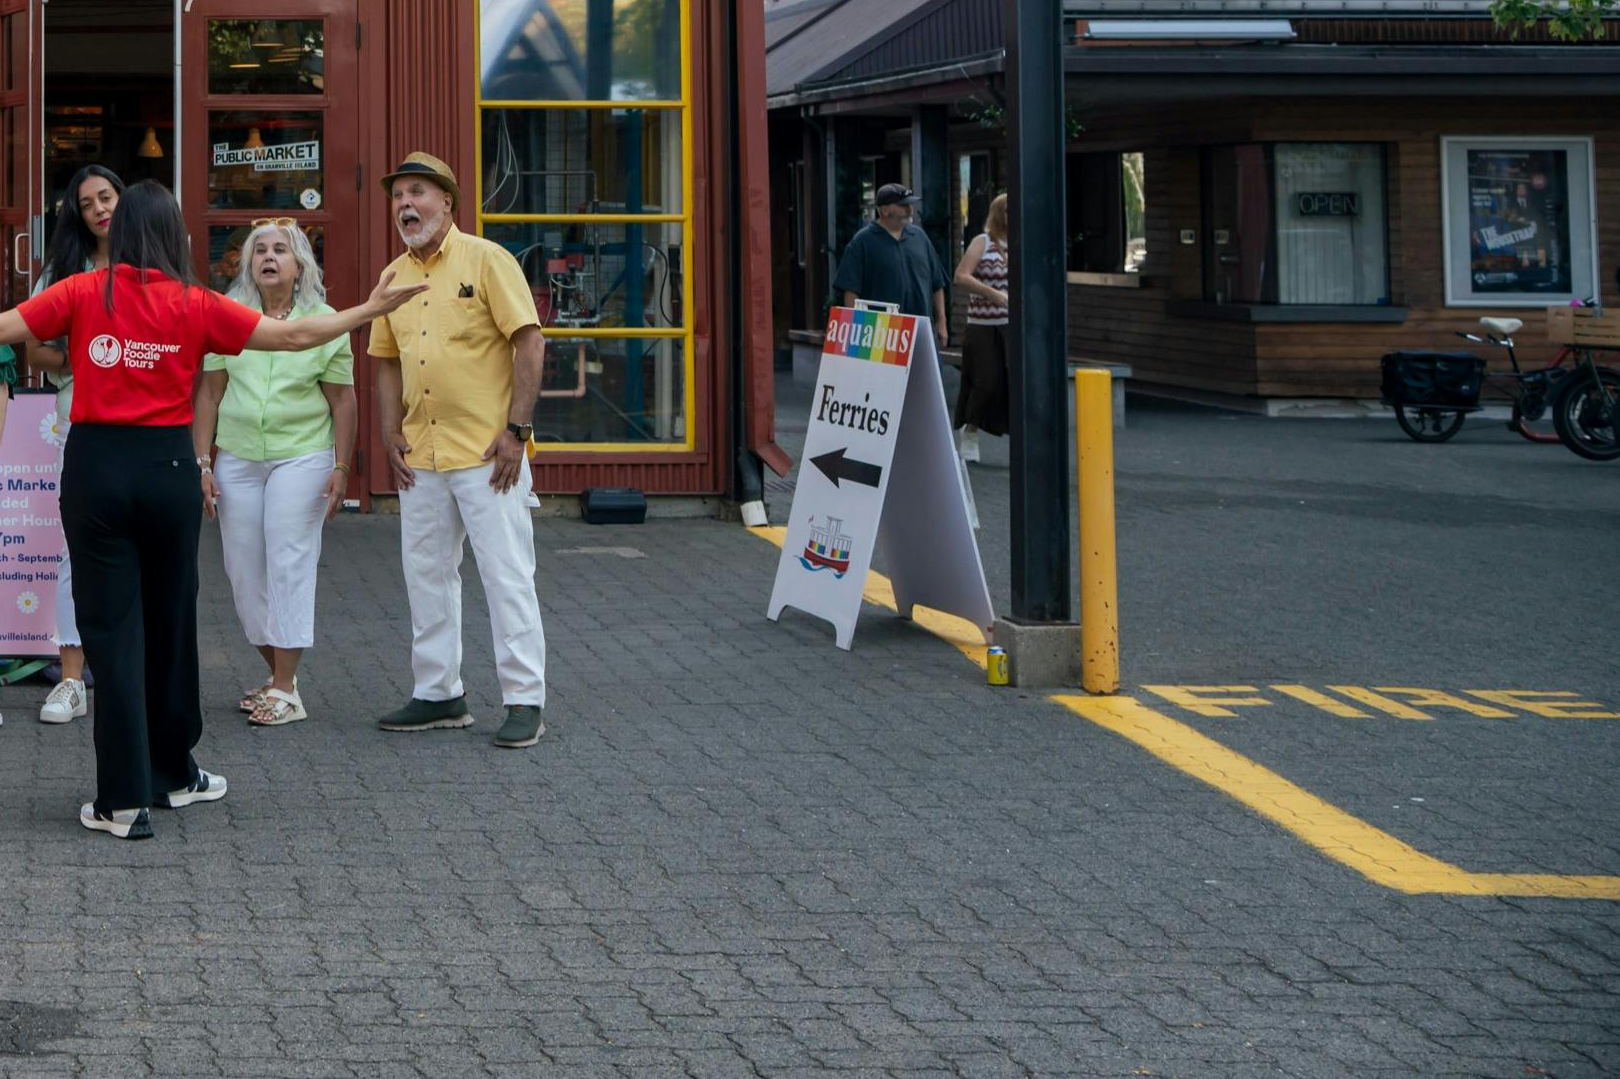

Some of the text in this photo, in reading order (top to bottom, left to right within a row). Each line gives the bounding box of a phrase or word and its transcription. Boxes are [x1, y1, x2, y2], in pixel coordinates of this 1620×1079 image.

[215, 143, 316, 164] PUBLIC MARKET
[1300, 193, 1358, 215] OPEN
[124, 339, 181, 353] Vancouver
[826, 318, 911, 355] aquabus
[123, 348, 161, 361] Foodie
[124, 357, 154, 369] Tours
[816, 384, 891, 436] Ferries
[1138, 684, 1620, 721] FIRE
